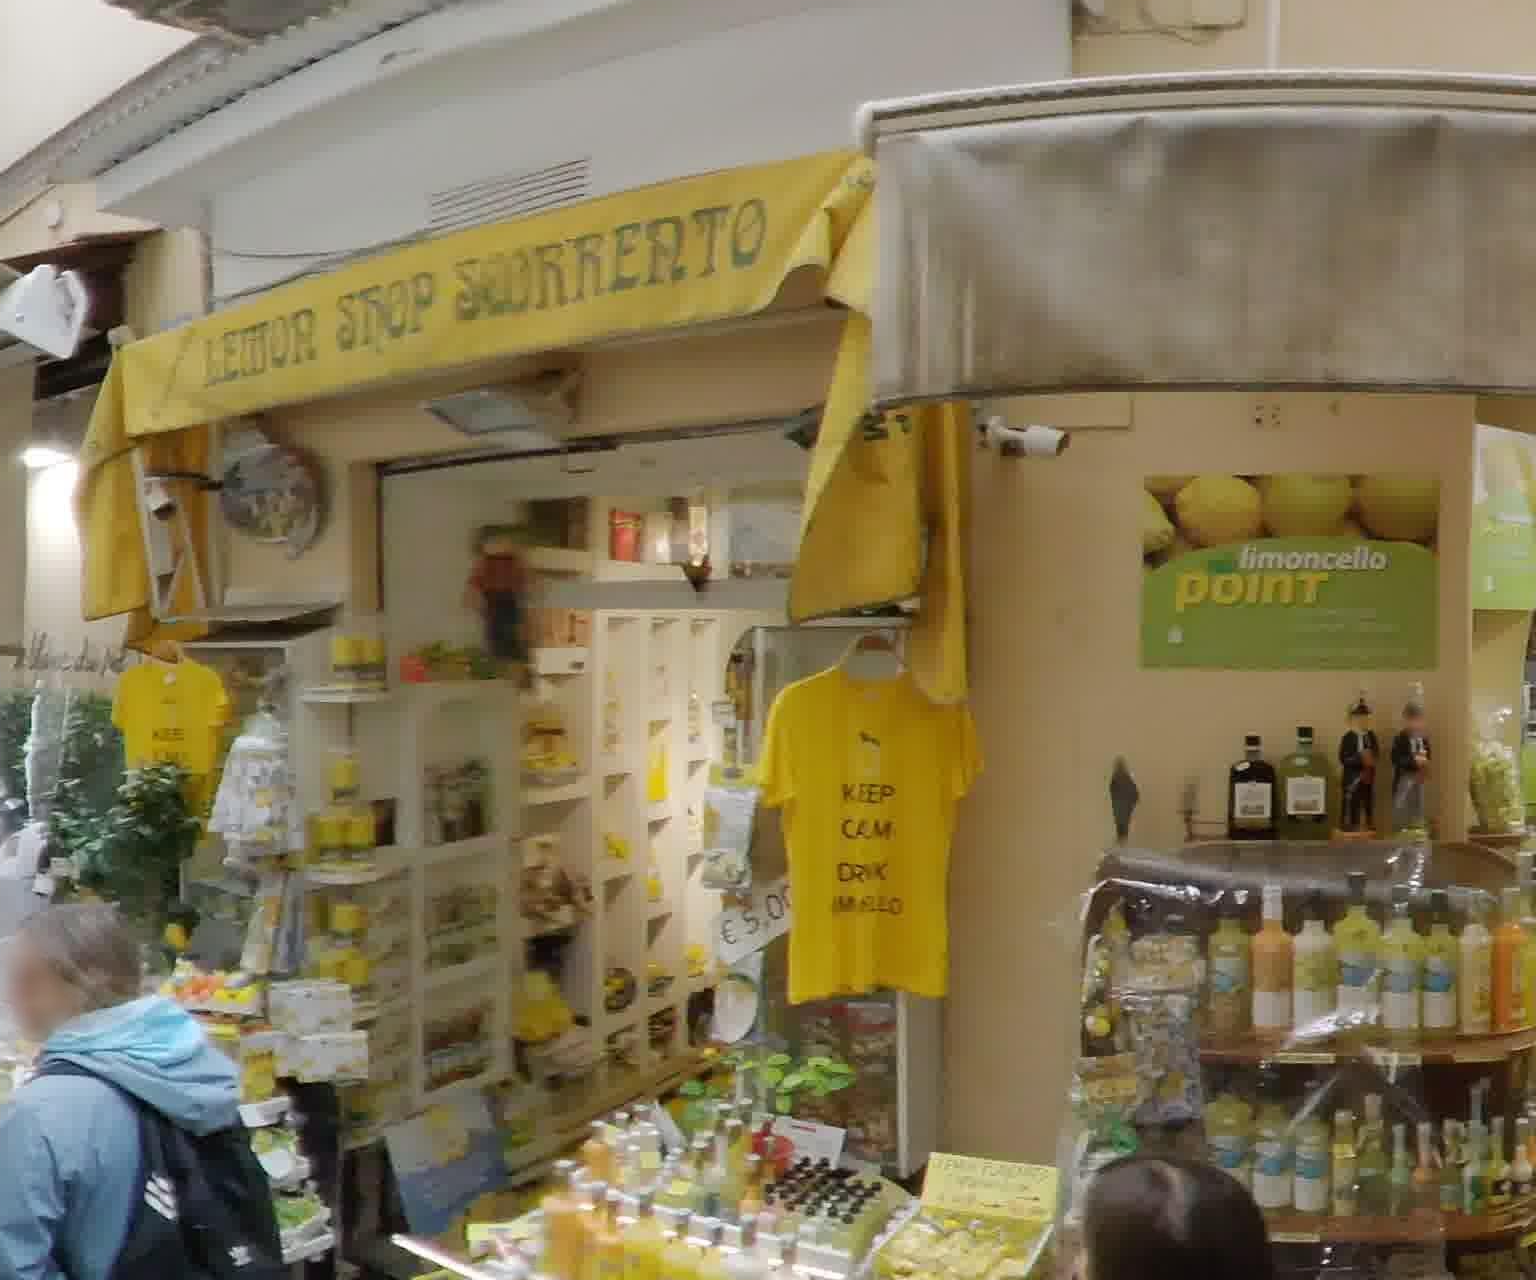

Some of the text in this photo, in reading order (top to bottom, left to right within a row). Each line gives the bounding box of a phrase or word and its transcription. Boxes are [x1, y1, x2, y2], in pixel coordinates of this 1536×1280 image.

[203, 308, 319, 386] LEMON
[1237, 543, 1390, 572] limoncello
[840, 782, 897, 805] KEEP
